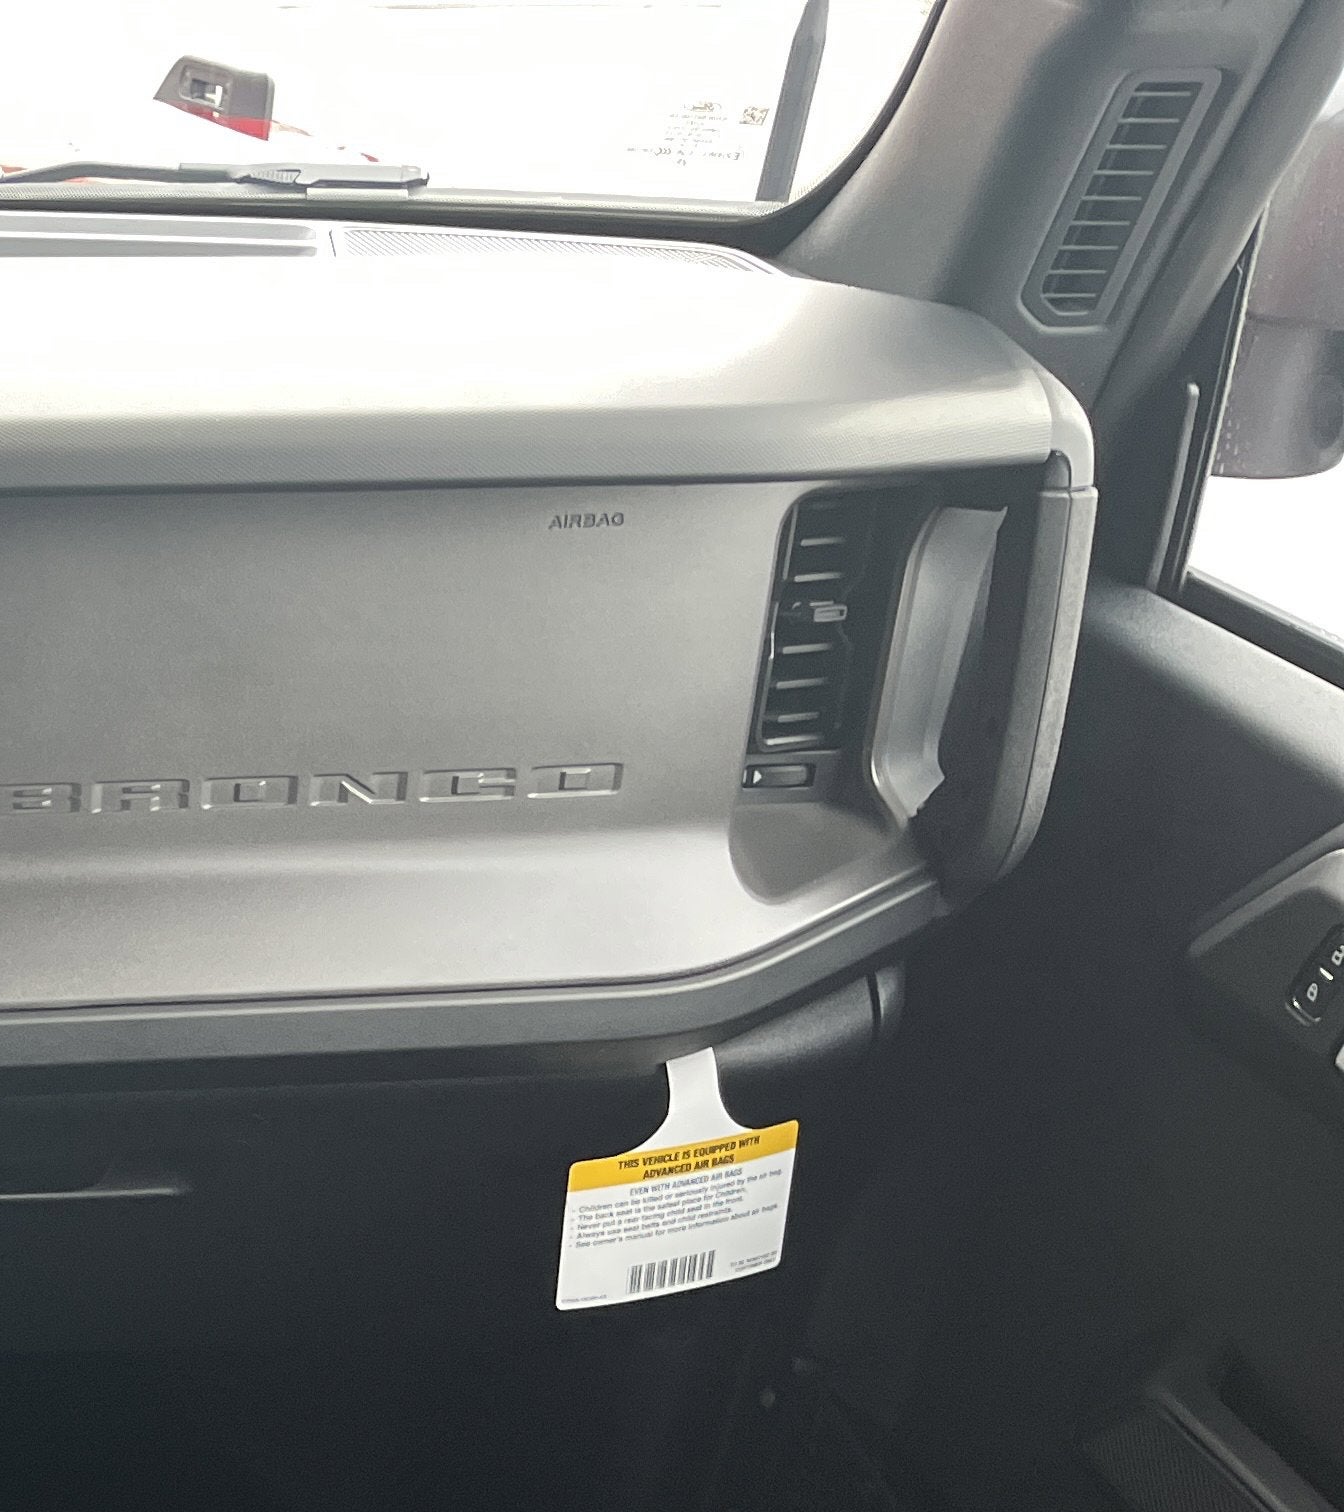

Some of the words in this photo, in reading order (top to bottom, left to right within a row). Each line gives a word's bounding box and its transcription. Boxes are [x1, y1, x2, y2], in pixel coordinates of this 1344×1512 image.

[548, 511, 625, 530] AIRBAG
[619, 1159, 639, 1170] THIS
[643, 1152, 680, 1167] VEHICLE
[682, 1151, 690, 1159] IS
[694, 1142, 736, 1157] EQUIPPED
[739, 1137, 760, 1148] WITH
[643, 1163, 691, 1179] ADVANCED
[694, 1160, 709, 1169] AIR
[712, 1155, 734, 1166] BAGS
